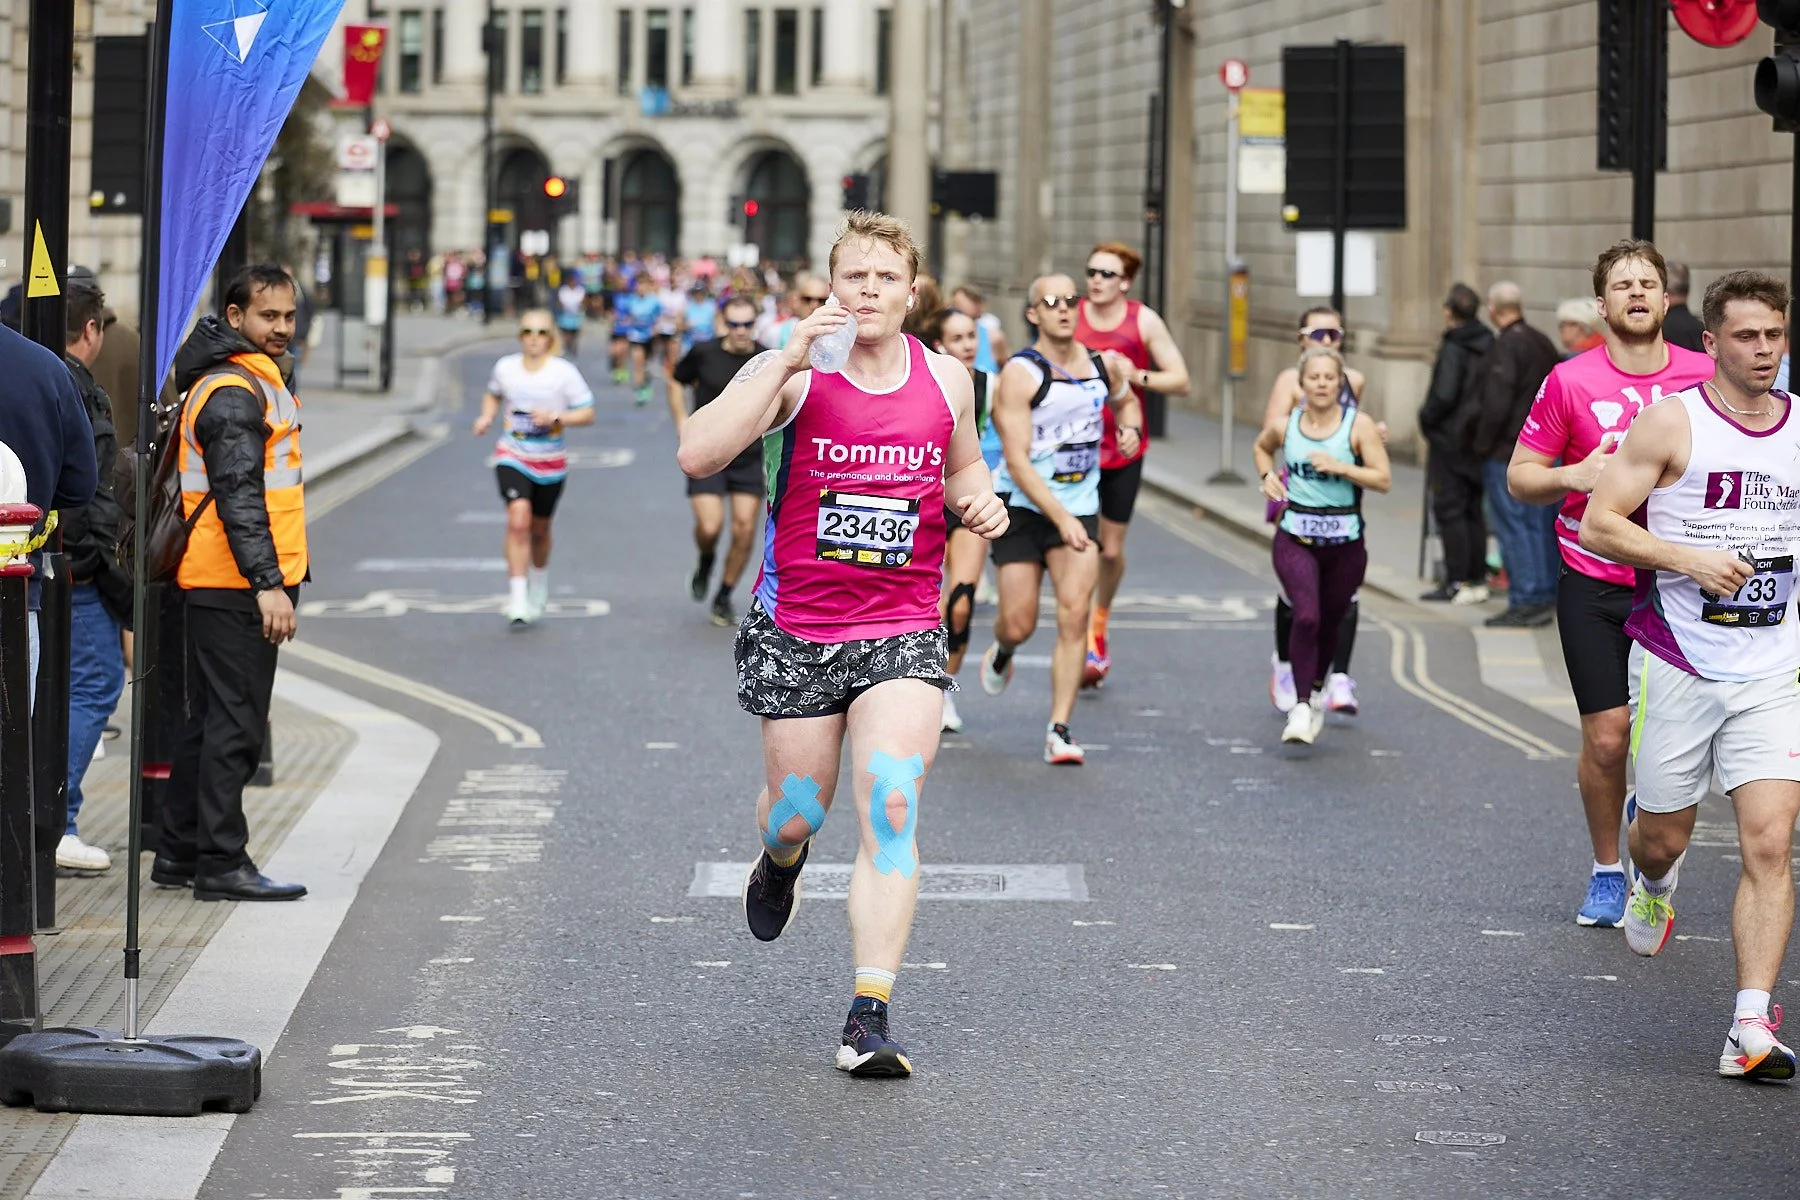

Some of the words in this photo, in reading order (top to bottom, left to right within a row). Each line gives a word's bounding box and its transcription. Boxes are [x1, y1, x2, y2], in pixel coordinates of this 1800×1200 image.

[811, 437, 943, 471] Tommy's
[809, 469, 825, 478] The
[826, 471, 873, 482] pregnancy
[874, 473, 892, 481] and
[893, 472, 914, 483] baby
[1745, 471, 1771, 483] The
[1744, 483, 1773, 499] Lily
[1776, 485, 1800, 498] Mae
[823, 512, 913, 543] 23436
[1682, 519, 1727, 532] Supporting
[1729, 522, 1758, 532] Parents
[1760, 524, 1776, 532] and
[1684, 530, 1722, 541] Stillbirth,
